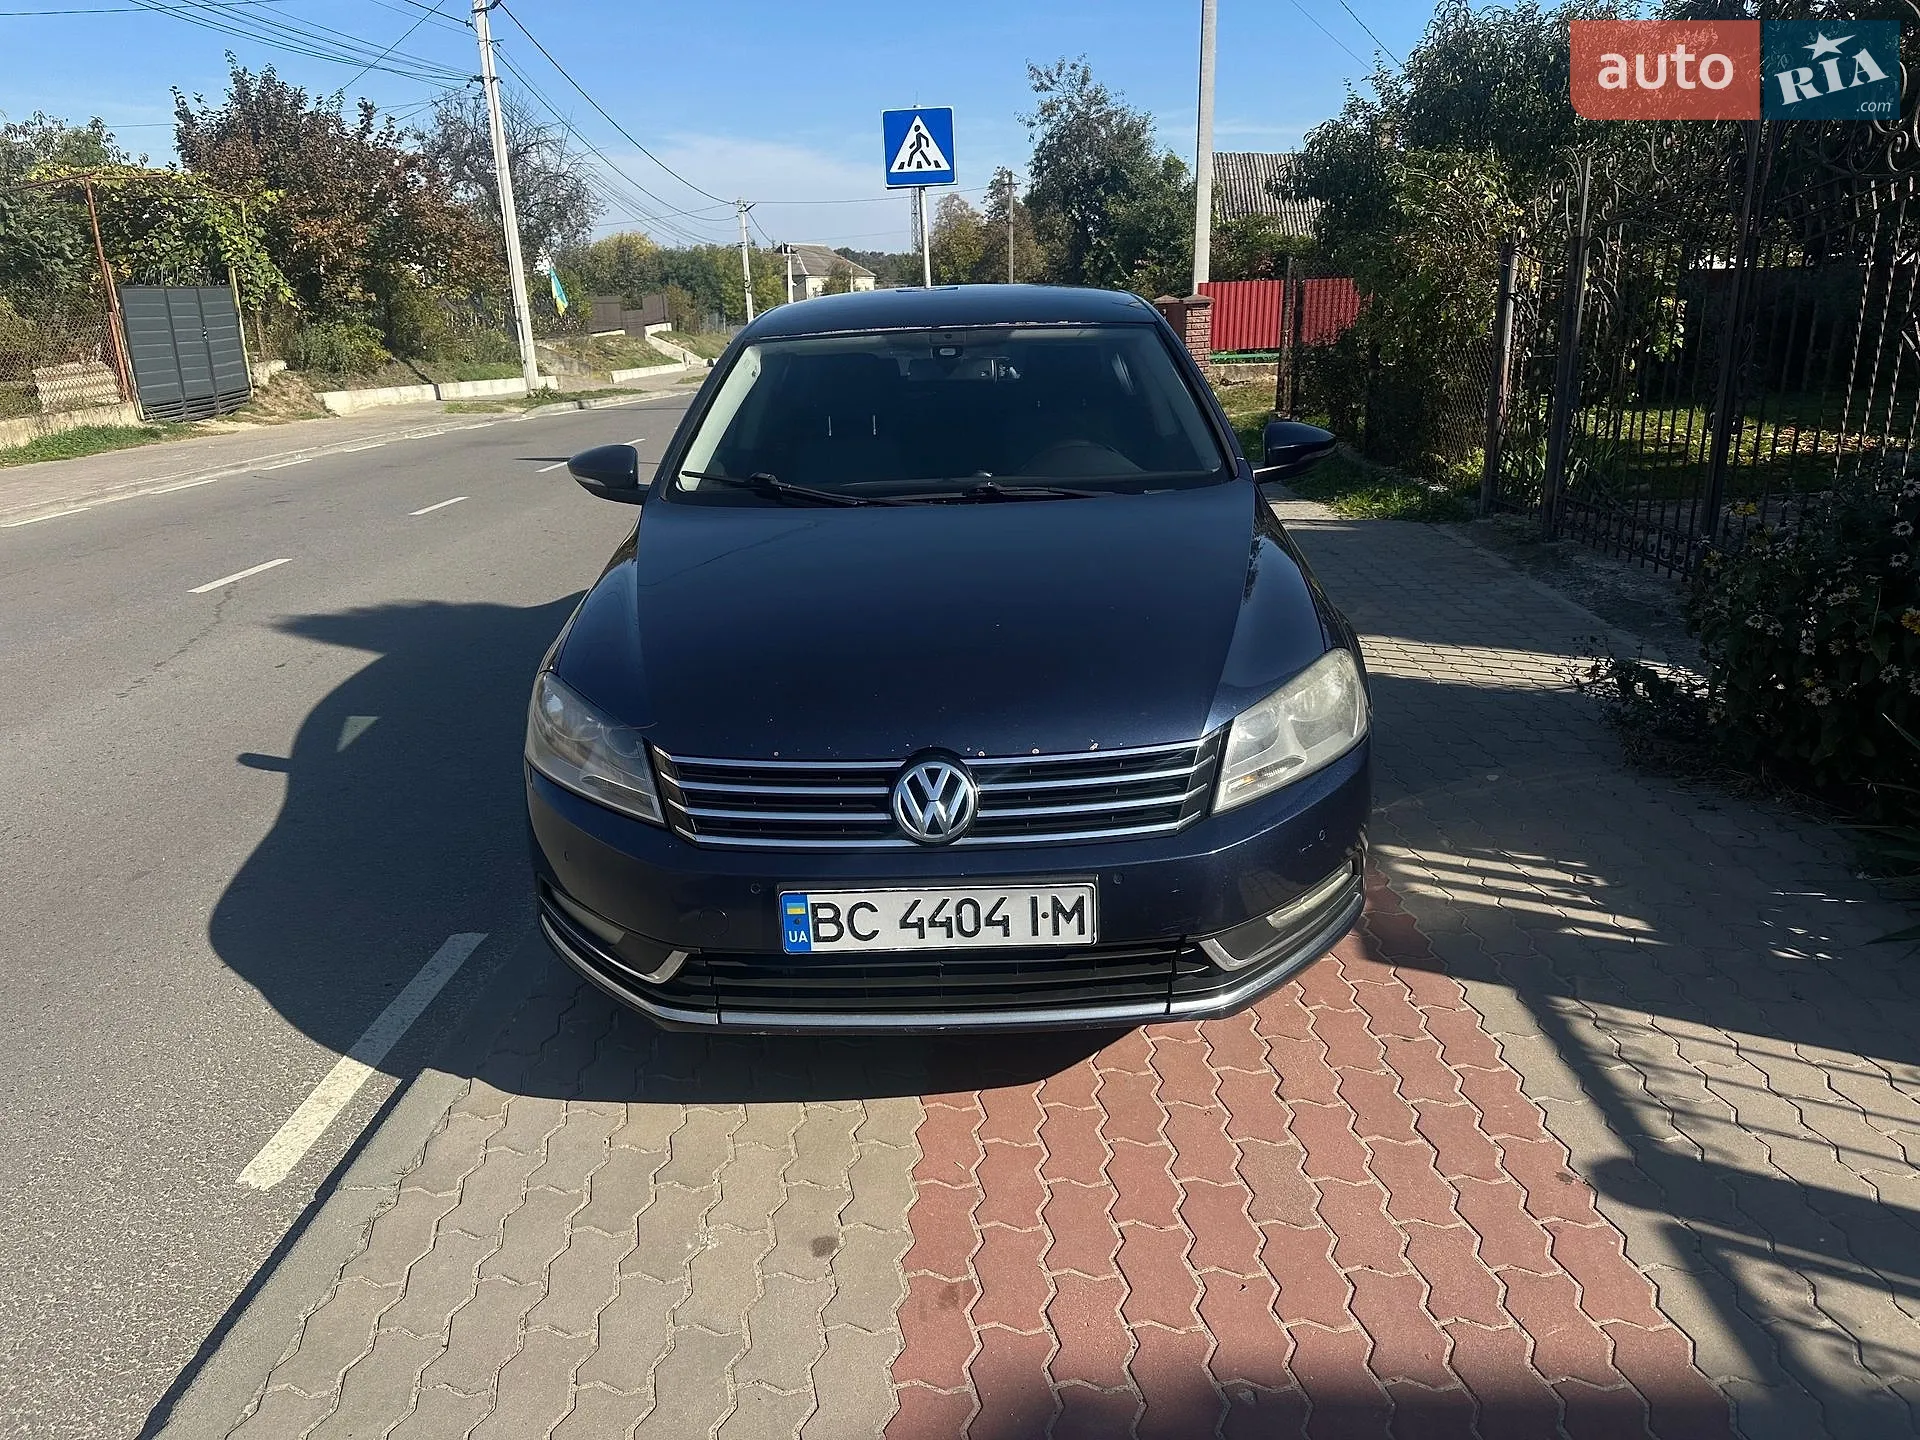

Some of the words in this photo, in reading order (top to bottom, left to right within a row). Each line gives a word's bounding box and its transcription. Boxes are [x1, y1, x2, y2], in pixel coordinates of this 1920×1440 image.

[810, 901, 881, 943] BC
[899, 896, 1011, 940] 4404
[1031, 895, 1086, 937] IM
[788, 930, 809, 944] UA
